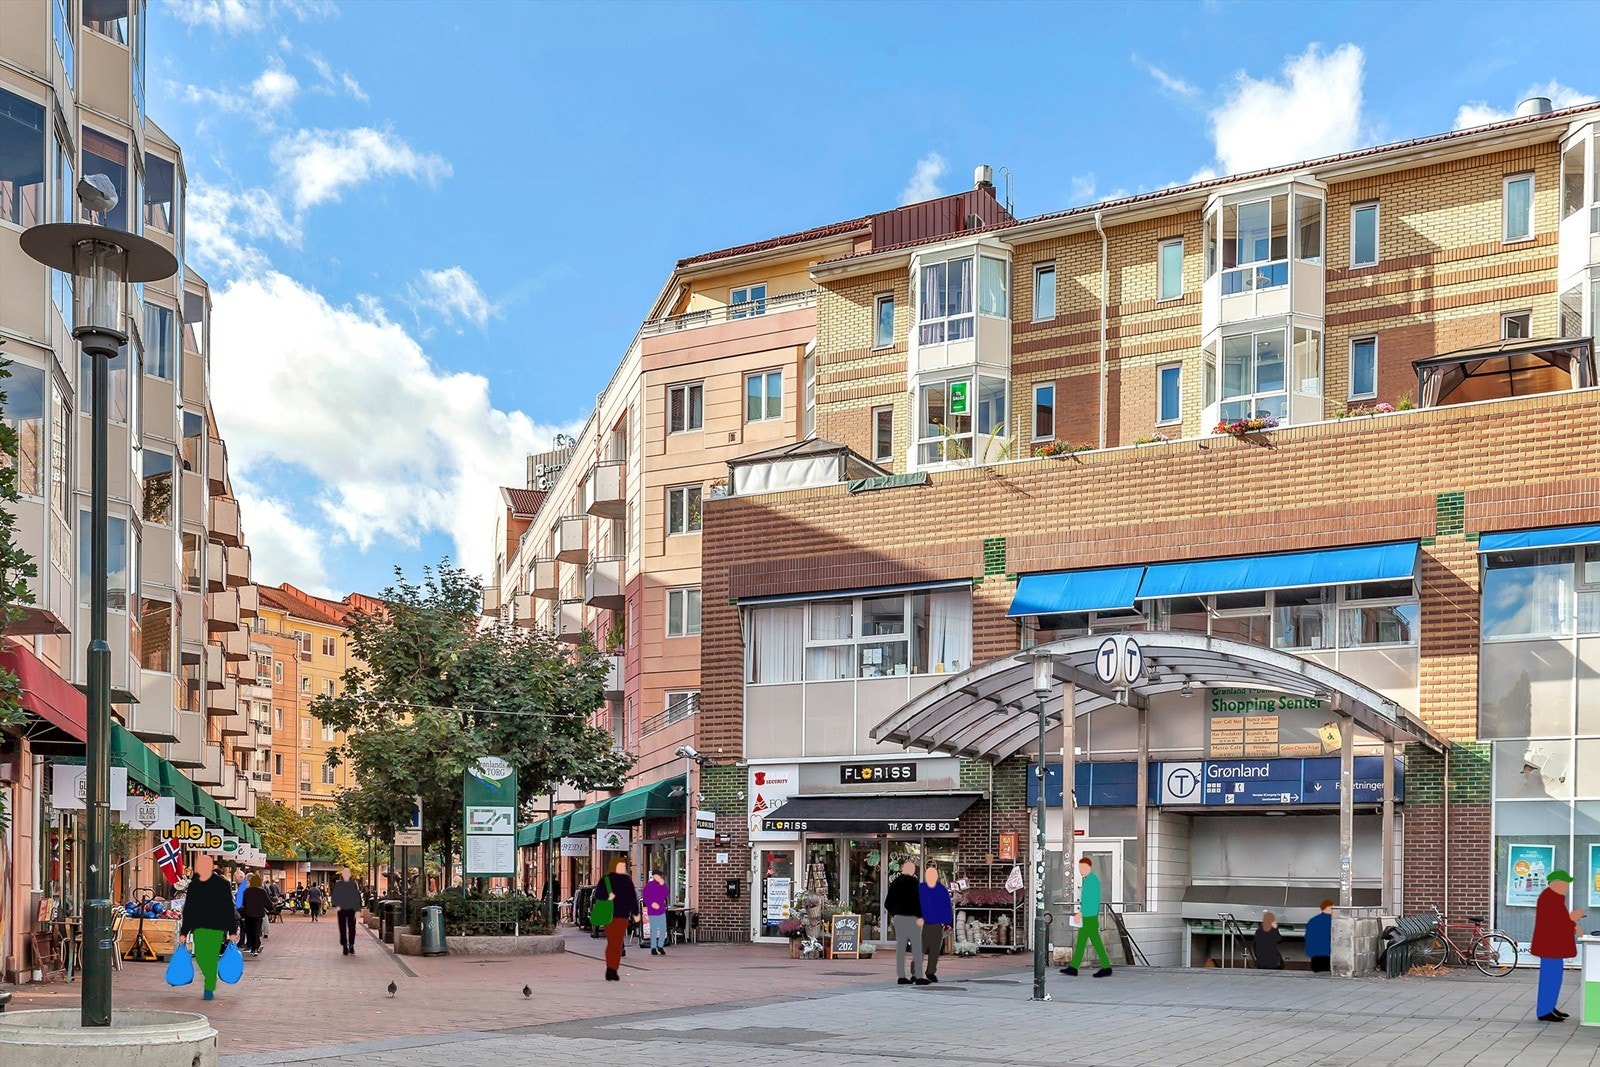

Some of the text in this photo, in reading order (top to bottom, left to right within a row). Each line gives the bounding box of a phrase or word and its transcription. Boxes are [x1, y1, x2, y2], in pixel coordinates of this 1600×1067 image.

[1212, 696, 1323, 713] Shopping Senter
[845, 766, 911, 780] FLORISS
[1207, 763, 1269, 778] Grønland
[1175, 775, 1189, 794] T
[765, 821, 808, 830] FLORISS
[901, 823, 913, 831] 22
[914, 823, 924, 831] 17
[925, 823, 936, 831] 58
[938, 823, 950, 831] 50
